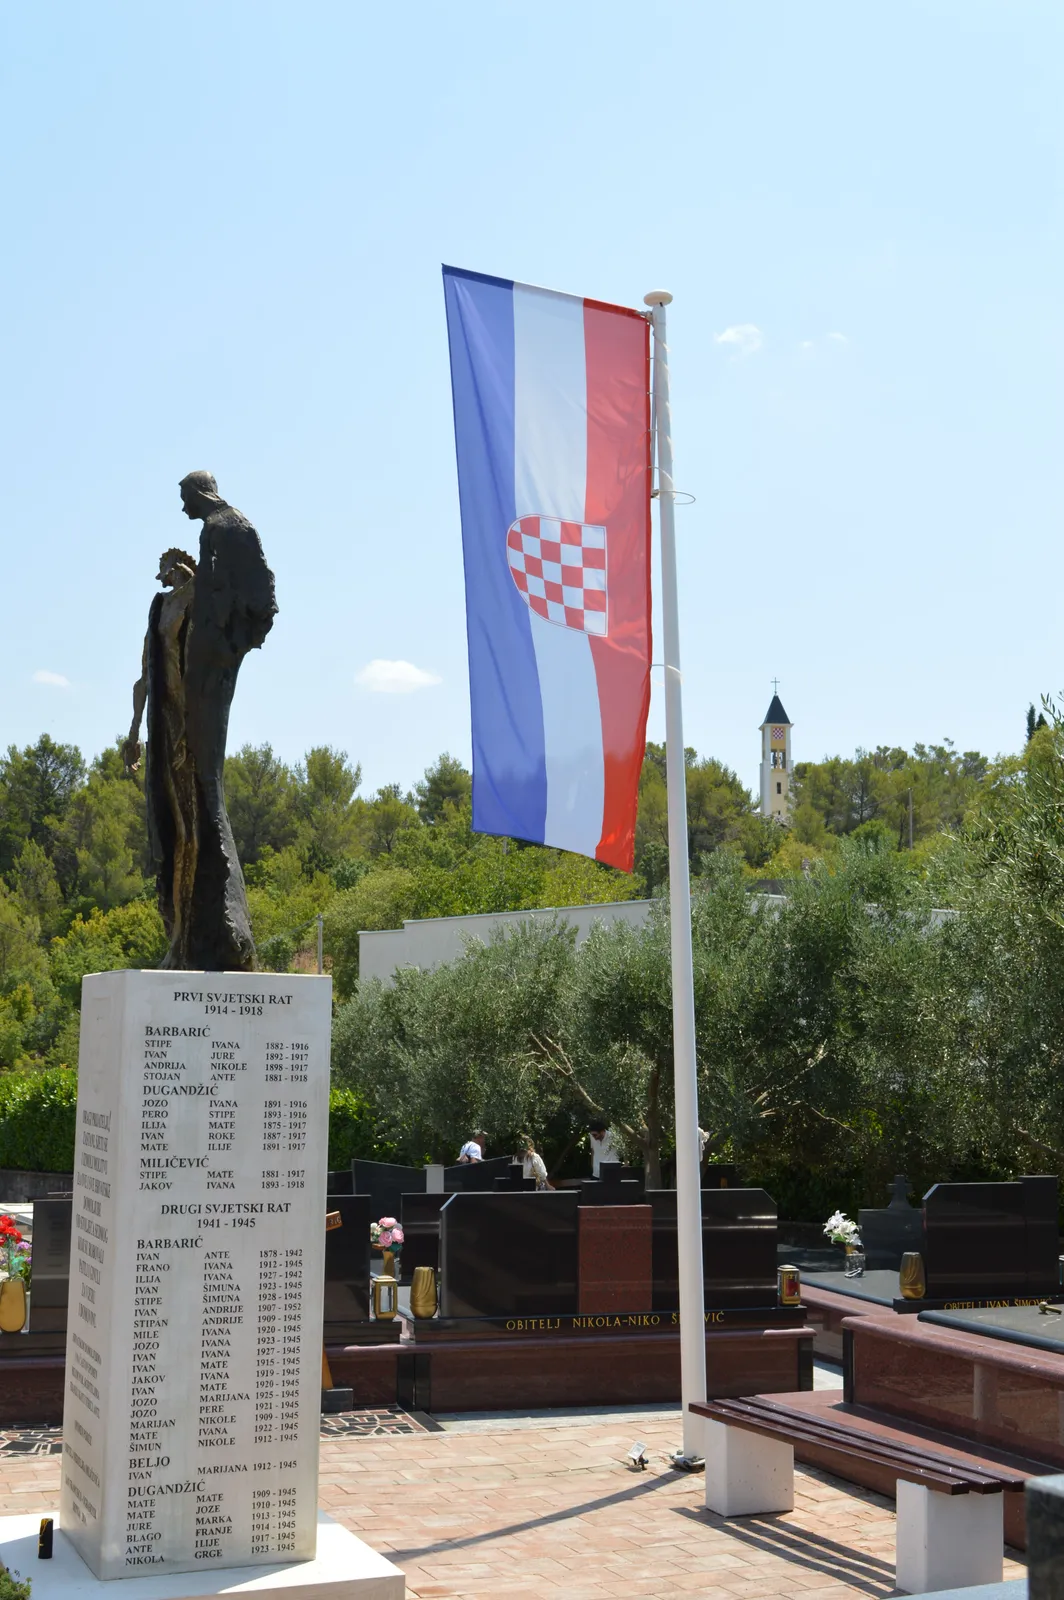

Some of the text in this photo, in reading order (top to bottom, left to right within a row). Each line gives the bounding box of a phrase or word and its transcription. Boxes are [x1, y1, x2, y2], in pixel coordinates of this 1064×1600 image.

[174, 992, 294, 1004] PRVI SVJETSKI RAT
[204, 1004, 262, 1016] 1914 1918
[144, 1024, 210, 1038] BARBARIĆ
[144, 1040, 310, 1050] STIPE IVANA 1882 1916
[144, 1050, 168, 1058] IVAN
[210, 1052, 234, 1060] JURE
[266, 1052, 284, 1060] 1892
[144, 1062, 308, 1072] ANDRIJA NIKOLE 1898 1917
[144, 1072, 308, 1082] STOJAN ANTE 1881 1918
[142, 1082, 218, 1096] DUGANDŽIĆ
[142, 1098, 308, 1108] JOZO IVANA 1891 1916
[142, 1110, 306, 1118] PERO STIPE 1893 1916
[142, 1122, 306, 1130] ILIJA MATE 1875 1917
[142, 1132, 164, 1140] IVAN
[208, 1132, 236, 1140] ROKE
[264, 1132, 282, 1140] 1887
[140, 1142, 306, 1152] MATE ILIJE 1891 1917
[140, 1154, 210, 1168] MILIČEVIĆ
[140, 1170, 304, 1180] STIPE MATE 1881 1917
[138, 1180, 304, 1190] JAKOV IVANA 1893 1918
[160, 1202, 292, 1214] DRUGI SVJETSKI RAT
[198, 1218, 256, 1228] 1941 1945
[138, 1236, 204, 1250] BARBARIĆ
[136, 1248, 302, 1260] IVAN ANTE 1878 1942
[136, 1260, 302, 1272] FRANO IVANA 1912 1945
[136, 1270, 302, 1284] ILIJA IVANA 1927 1942
[136, 1282, 302, 1294] IVAN ŠIMUNA 1923 1945
[134, 1292, 302, 1306] STIPE ŠIMUNA 1928 1945
[986, 1300, 1010, 1308] IVAN
[134, 1302, 302, 1316] IVAN ANDRIJE 1907 1952
[134, 1314, 302, 1328] STIPAN ANDRIJE 1909 1945
[506, 1311, 725, 1330] OBITELJ NIKOLA-NIKO ŠVIĆ
[134, 1324, 300, 1340] MILE IVANA 1920 1945
[132, 1356, 300, 1374] IVAN MATE 1915 1945
[132, 1368, 300, 1384] JAKOV IVANA 1919 1945
[130, 1390, 300, 1408] JOZO MARIJANA 1925 1945
[130, 1400, 300, 1418] JOZO PERE 1921 1945
[130, 1412, 298, 1430] MARIJAN NIKOLE 1909 1945
[130, 1422, 298, 1440] MATE IVANA 1922 1945
[130, 1434, 298, 1452] ŠIMUN NIKOLE 1912 1945
[128, 1456, 170, 1468] BELJO
[128, 1460, 298, 1480] IVAN MARIJANA 1912 1945
[128, 1480, 206, 1498] DUGANDŽIĆ
[128, 1488, 296, 1508] MATE MATE 1909 1945
[126, 1510, 296, 1532] JURE MARKA 1913 1945
[126, 1520, 296, 1542] BLAGO FRANJE 1914 1945
[126, 1532, 296, 1554] ANTE ILIJE 1917 1945
[126, 1542, 296, 1566] NIKOLA GRGE 1923 1945
